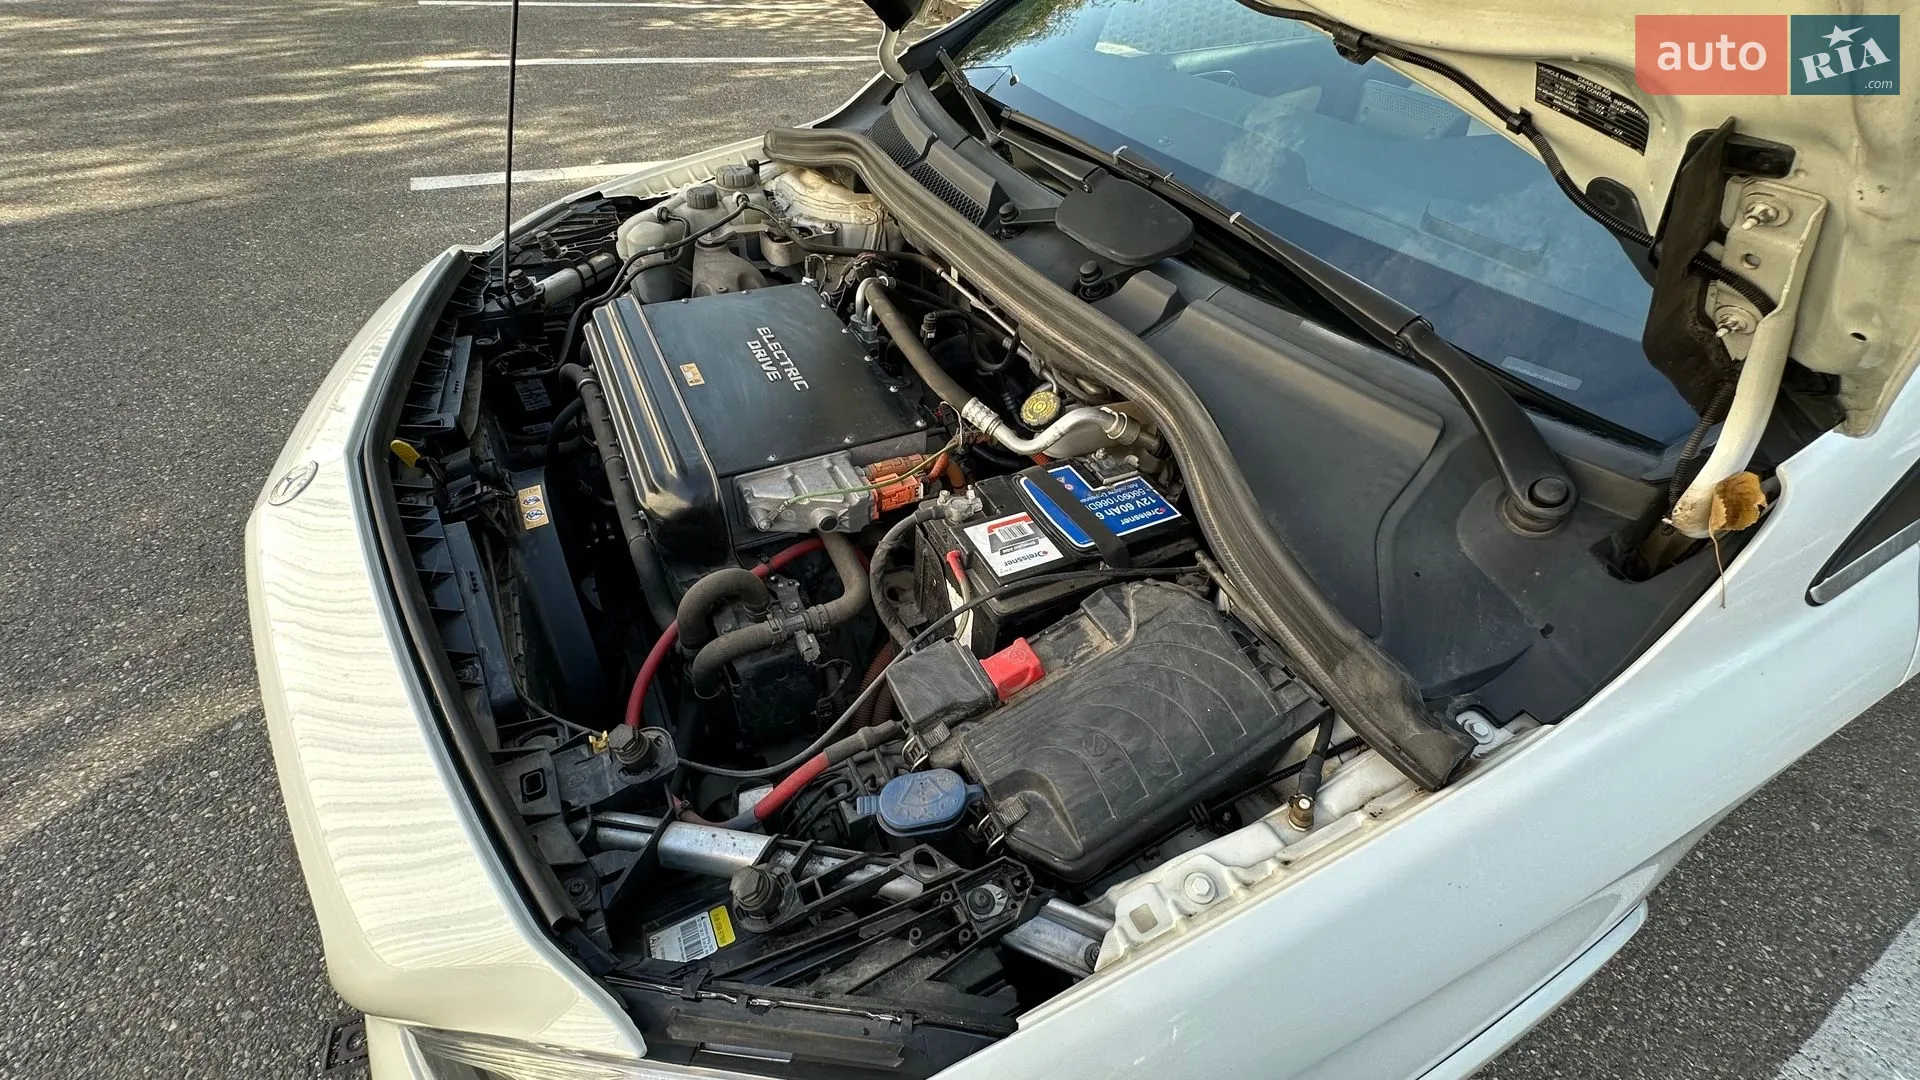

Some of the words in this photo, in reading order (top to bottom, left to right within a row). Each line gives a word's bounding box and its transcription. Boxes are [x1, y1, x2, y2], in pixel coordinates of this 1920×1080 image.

[747, 340, 782, 382] DRIVE
[756, 326, 810, 391] ELECTRIC
[1104, 502, 1135, 517] 60Ah
[1135, 496, 1157, 509] 12V
[1120, 507, 1166, 526] Dreissner
[1004, 550, 1049, 567] Dreissner
